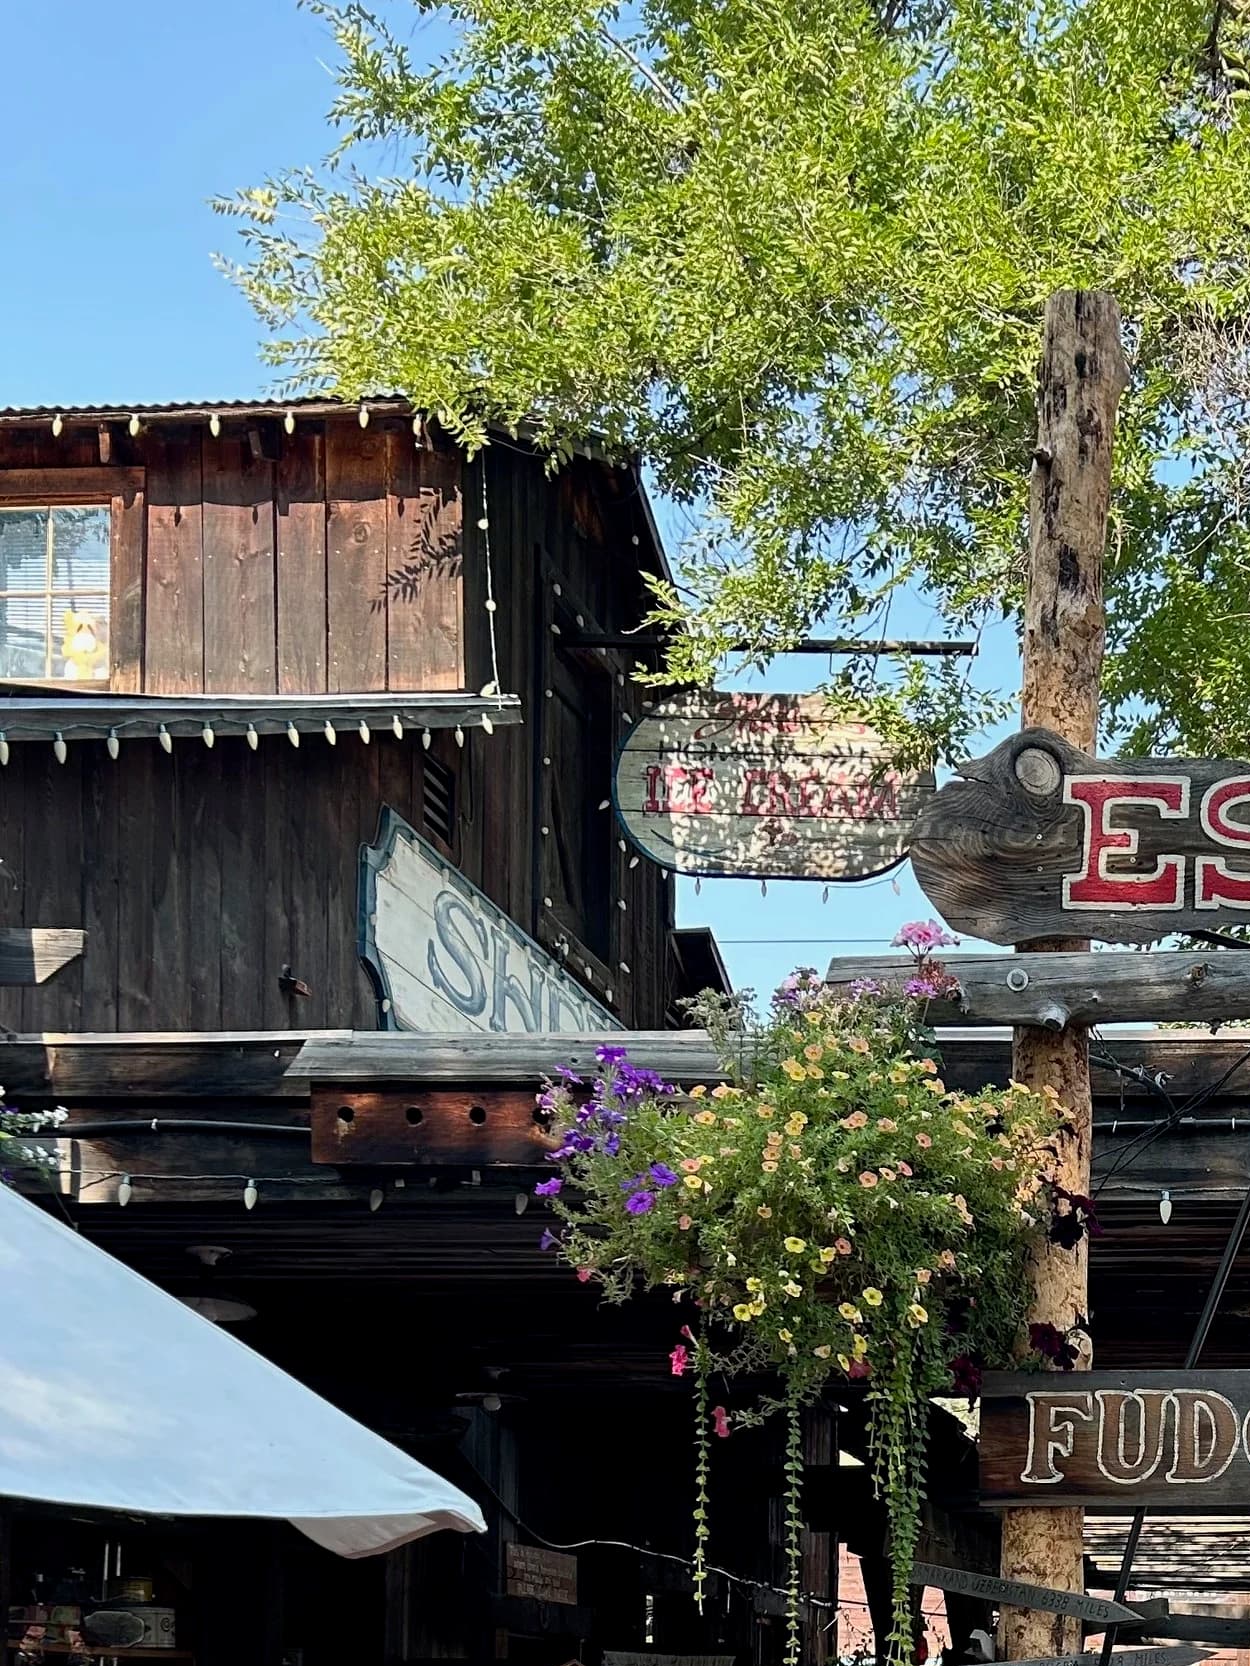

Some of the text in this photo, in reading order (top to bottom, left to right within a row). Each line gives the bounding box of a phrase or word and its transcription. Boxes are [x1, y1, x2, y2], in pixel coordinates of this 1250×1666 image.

[643, 765, 713, 814] ICE
[1077, 1598, 1110, 1619] MILES
[1134, 1651, 1167, 1666] MILES
